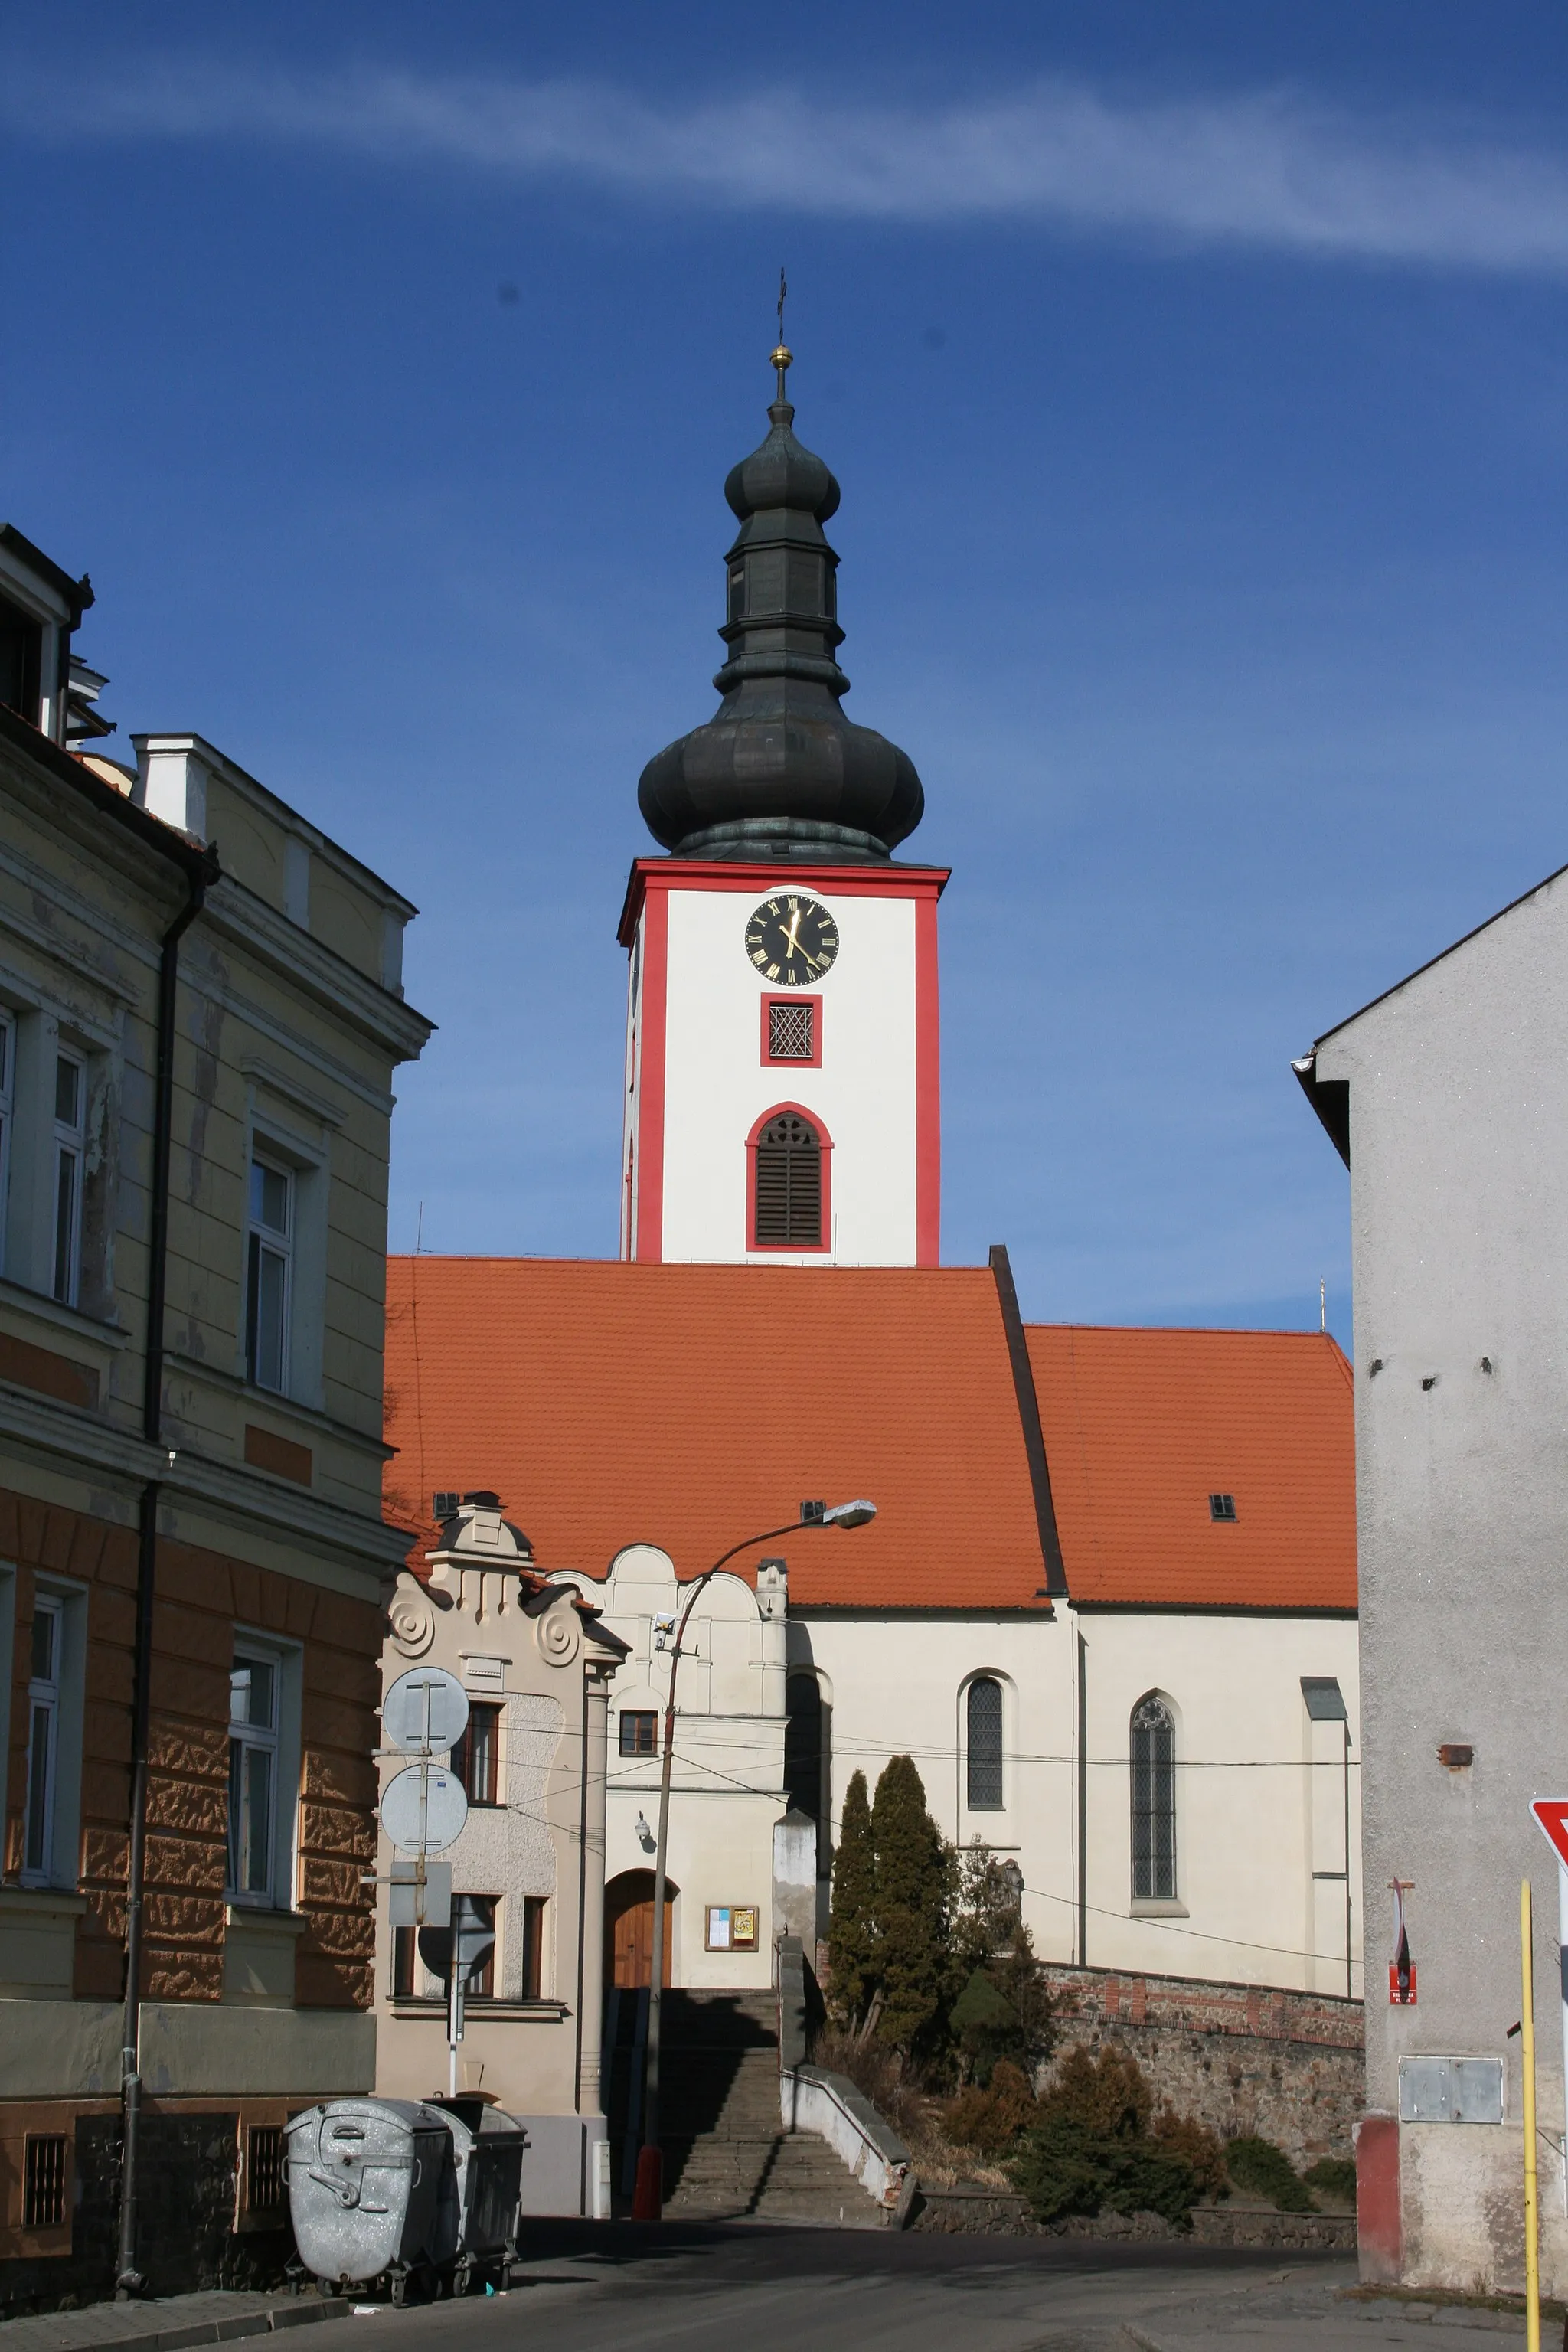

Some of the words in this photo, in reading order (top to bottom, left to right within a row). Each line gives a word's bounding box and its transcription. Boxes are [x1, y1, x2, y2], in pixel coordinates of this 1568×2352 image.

[768, 902, 780, 916] XI
[788, 898, 797, 911] XII
[753, 916, 767, 927] X
[818, 919, 831, 929] II
[766, 963, 780, 978] VII
[788, 969, 795, 982] VI
[806, 966, 815, 979] V
